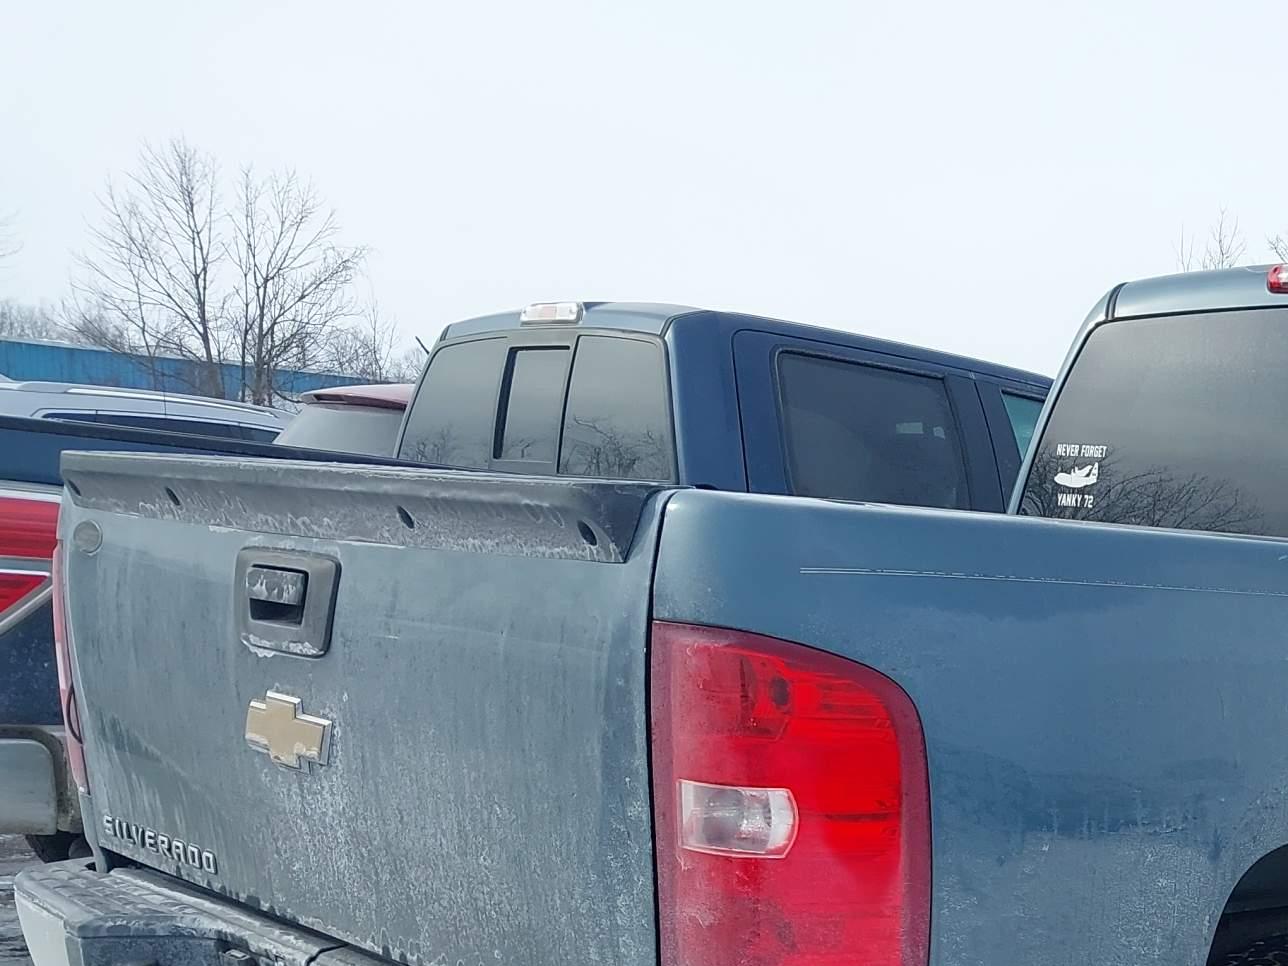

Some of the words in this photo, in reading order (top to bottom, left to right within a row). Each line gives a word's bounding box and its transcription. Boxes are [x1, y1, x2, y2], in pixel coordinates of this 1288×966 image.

[1057, 444, 1080, 457] NEVER
[1081, 445, 1107, 457] FORGET
[1058, 494, 1082, 507] YANKY
[1084, 495, 1094, 508] 72
[103, 815, 217, 874] SILVERADO
